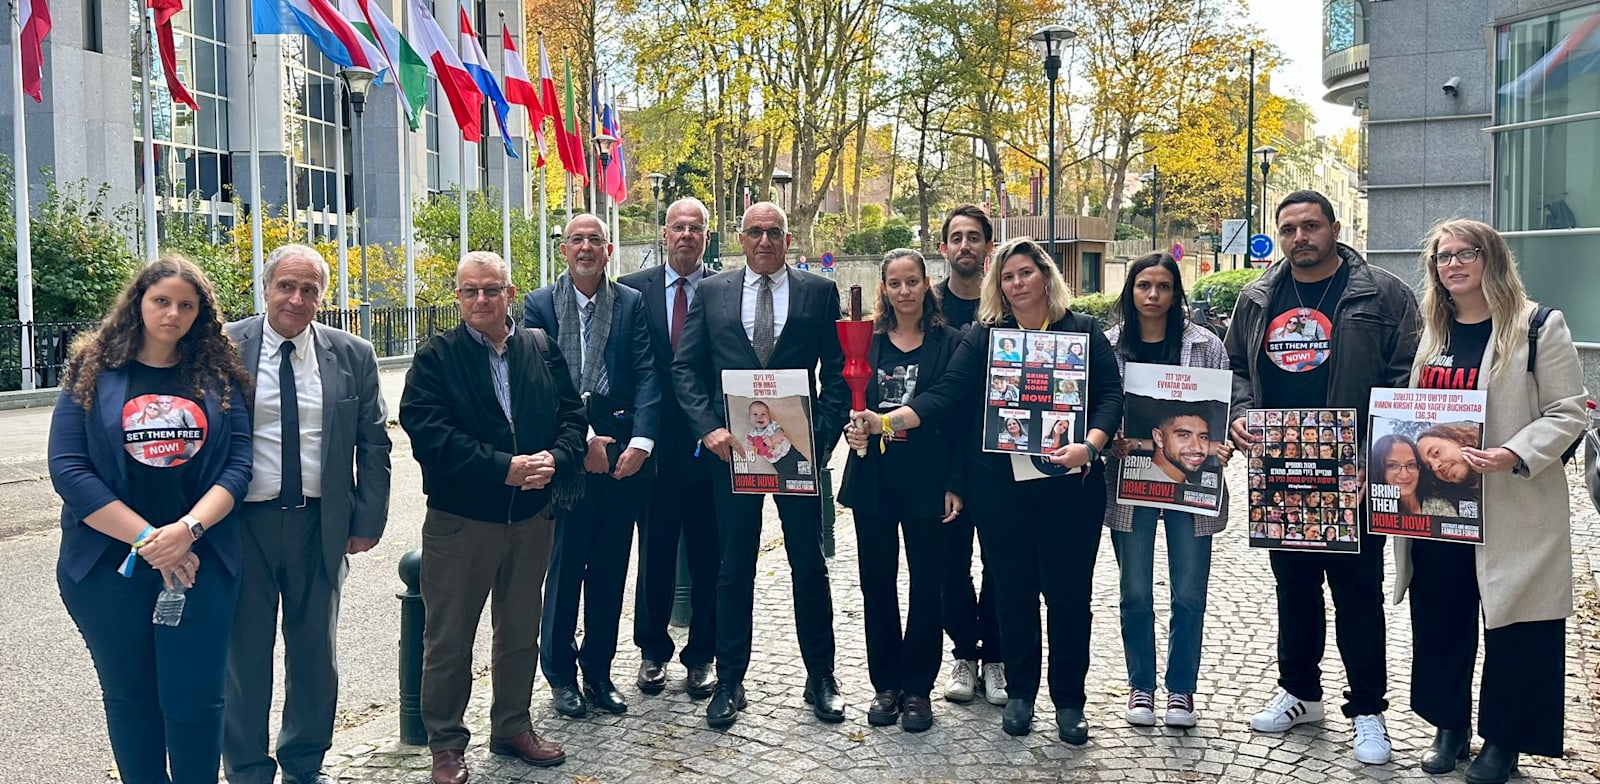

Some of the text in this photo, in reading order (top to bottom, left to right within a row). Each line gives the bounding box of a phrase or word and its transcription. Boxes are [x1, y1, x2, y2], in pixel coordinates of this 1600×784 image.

[1286, 352, 1311, 362] NOW!
[1158, 381, 1180, 390] EVYATAR
[1021, 394, 1052, 402] NOW!
[1428, 403, 1446, 411] YAGEV
[1447, 404, 1482, 412] BUCHSHTAB
[1415, 411, 1437, 420] (36,34)
[126, 430, 200, 441] SET THEM FREE
[149, 443, 179, 455] NOW!
[734, 450, 756, 462] BNG
[1125, 456, 1152, 468] BRING
[735, 463, 749, 474] HIM
[1123, 468, 1140, 480] HIM
[735, 475, 756, 487] HOME
[758, 476, 778, 487] NOW!
[1122, 481, 1147, 494] HOME
[1148, 483, 1175, 497] NOW!
[1371, 483, 1400, 499] BRING
[1371, 498, 1398, 513] THEM
[1372, 513, 1399, 528] HOME
[1402, 515, 1431, 531] NOW!
